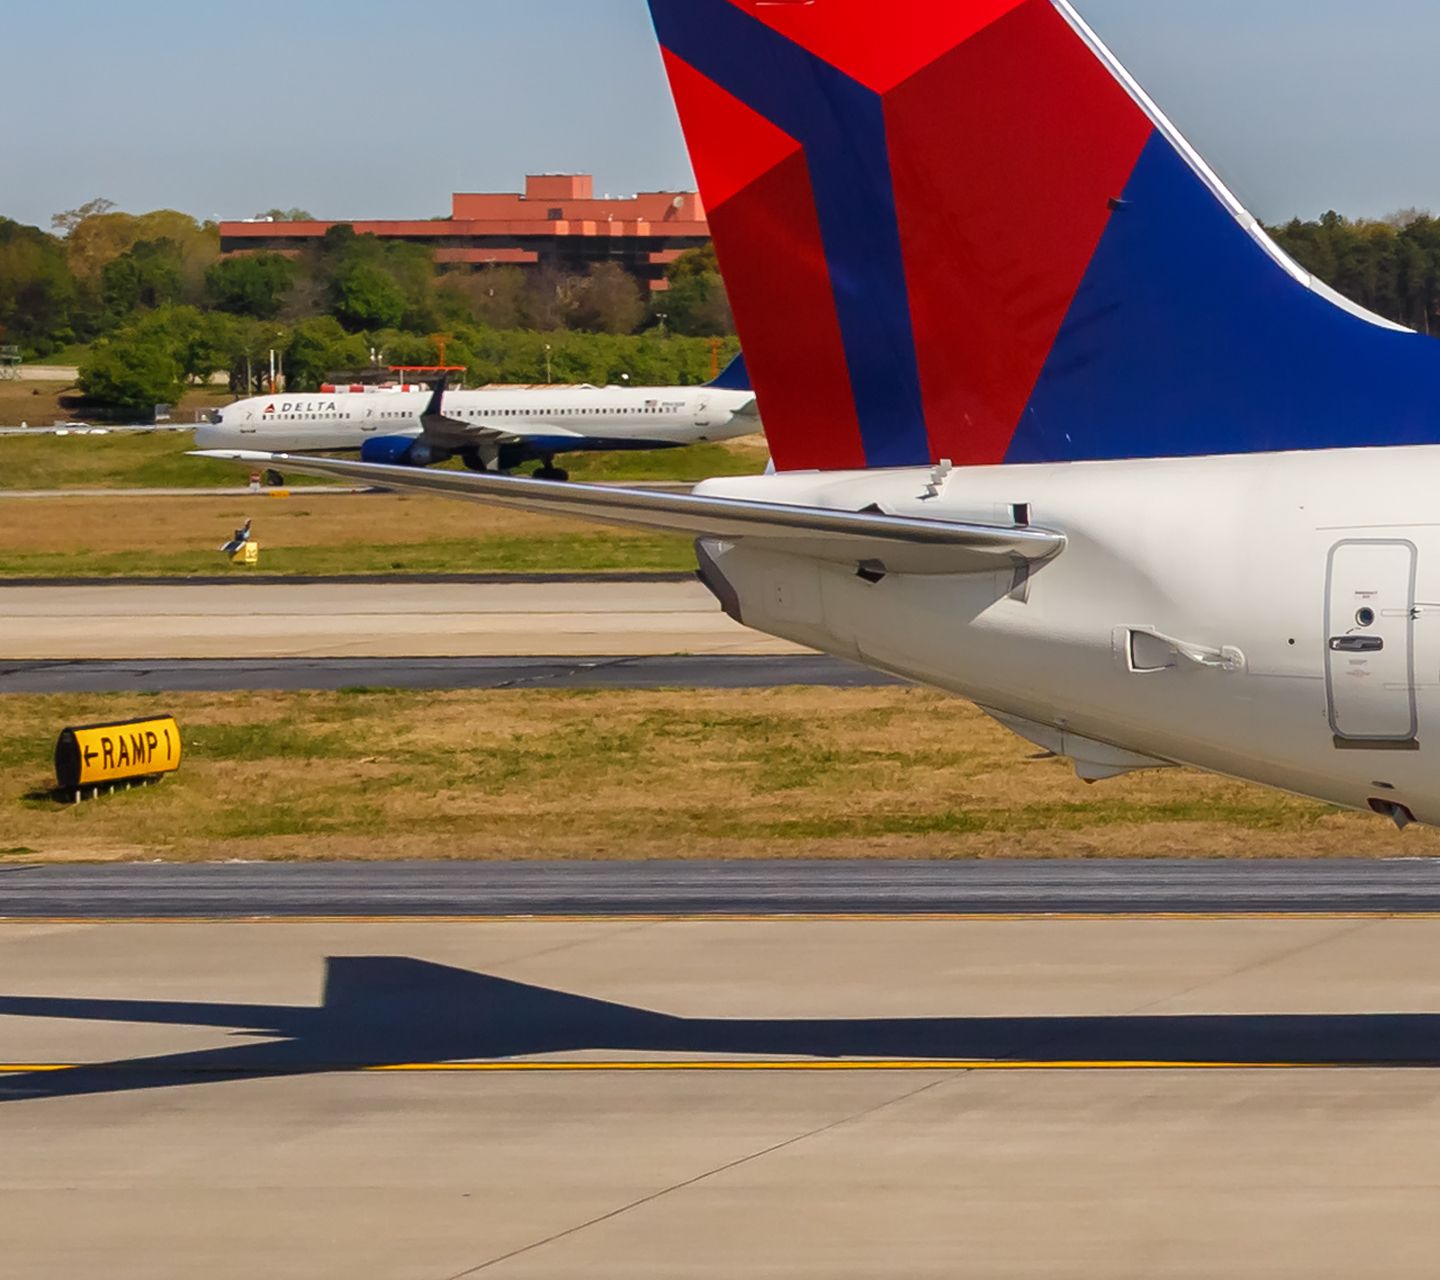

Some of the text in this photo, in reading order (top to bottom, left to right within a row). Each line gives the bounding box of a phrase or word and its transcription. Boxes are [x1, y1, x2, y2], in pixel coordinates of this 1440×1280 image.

[281, 401, 336, 412] DELTA
[100, 728, 171, 770] RAMP 1
